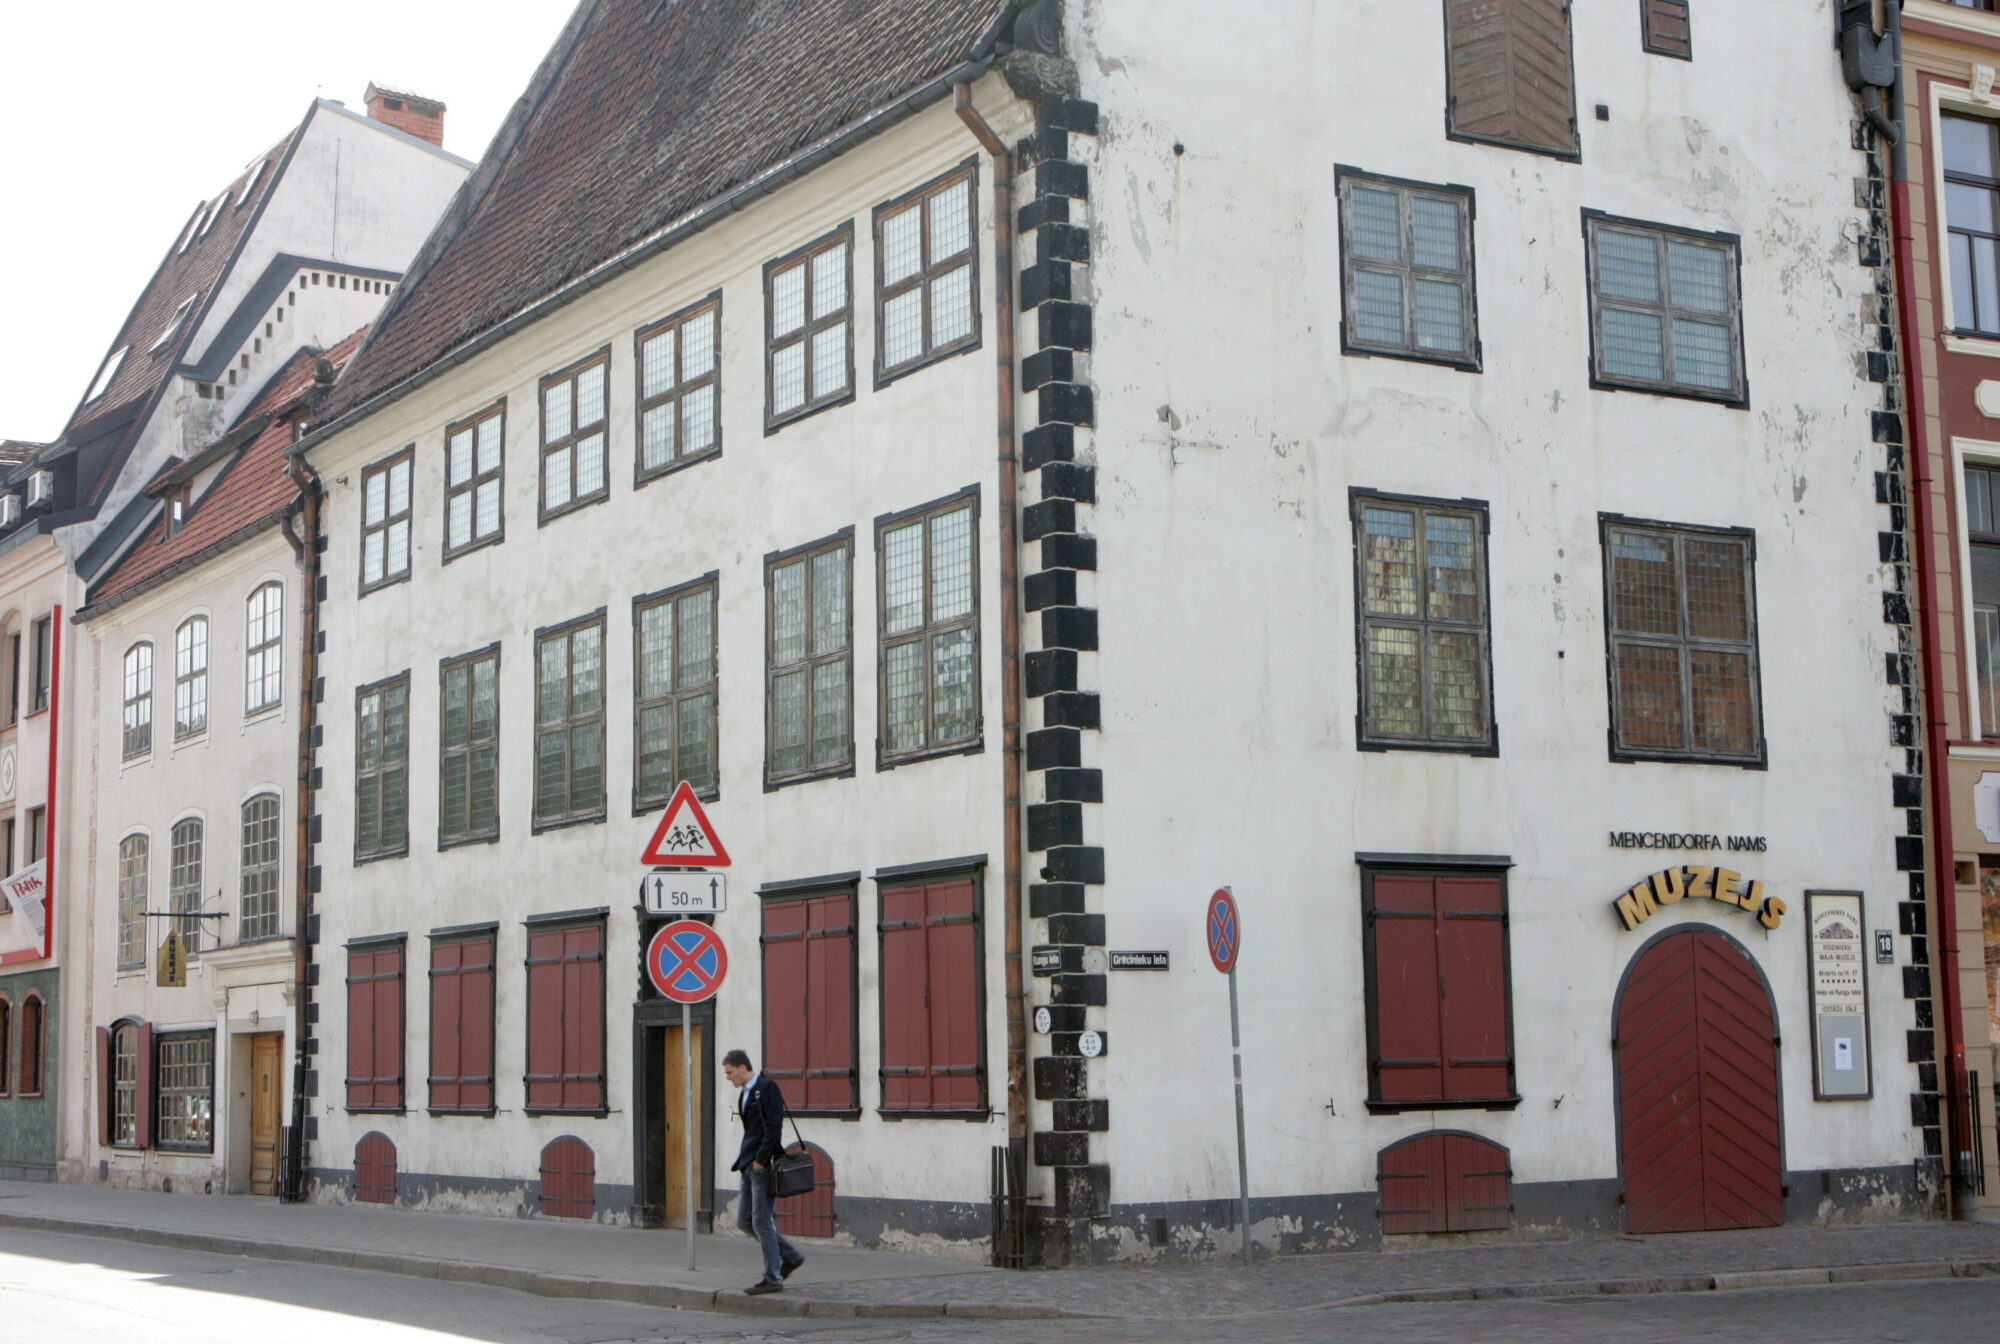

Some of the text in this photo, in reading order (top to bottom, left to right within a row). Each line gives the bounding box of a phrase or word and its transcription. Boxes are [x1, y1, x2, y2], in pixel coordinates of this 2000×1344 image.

[1609, 831, 1767, 851] MENCENDORFA NAMS
[671, 891, 703, 905] 50 m
[1612, 865, 1788, 931] MUZEJS
[1880, 937, 1891, 951] 18
